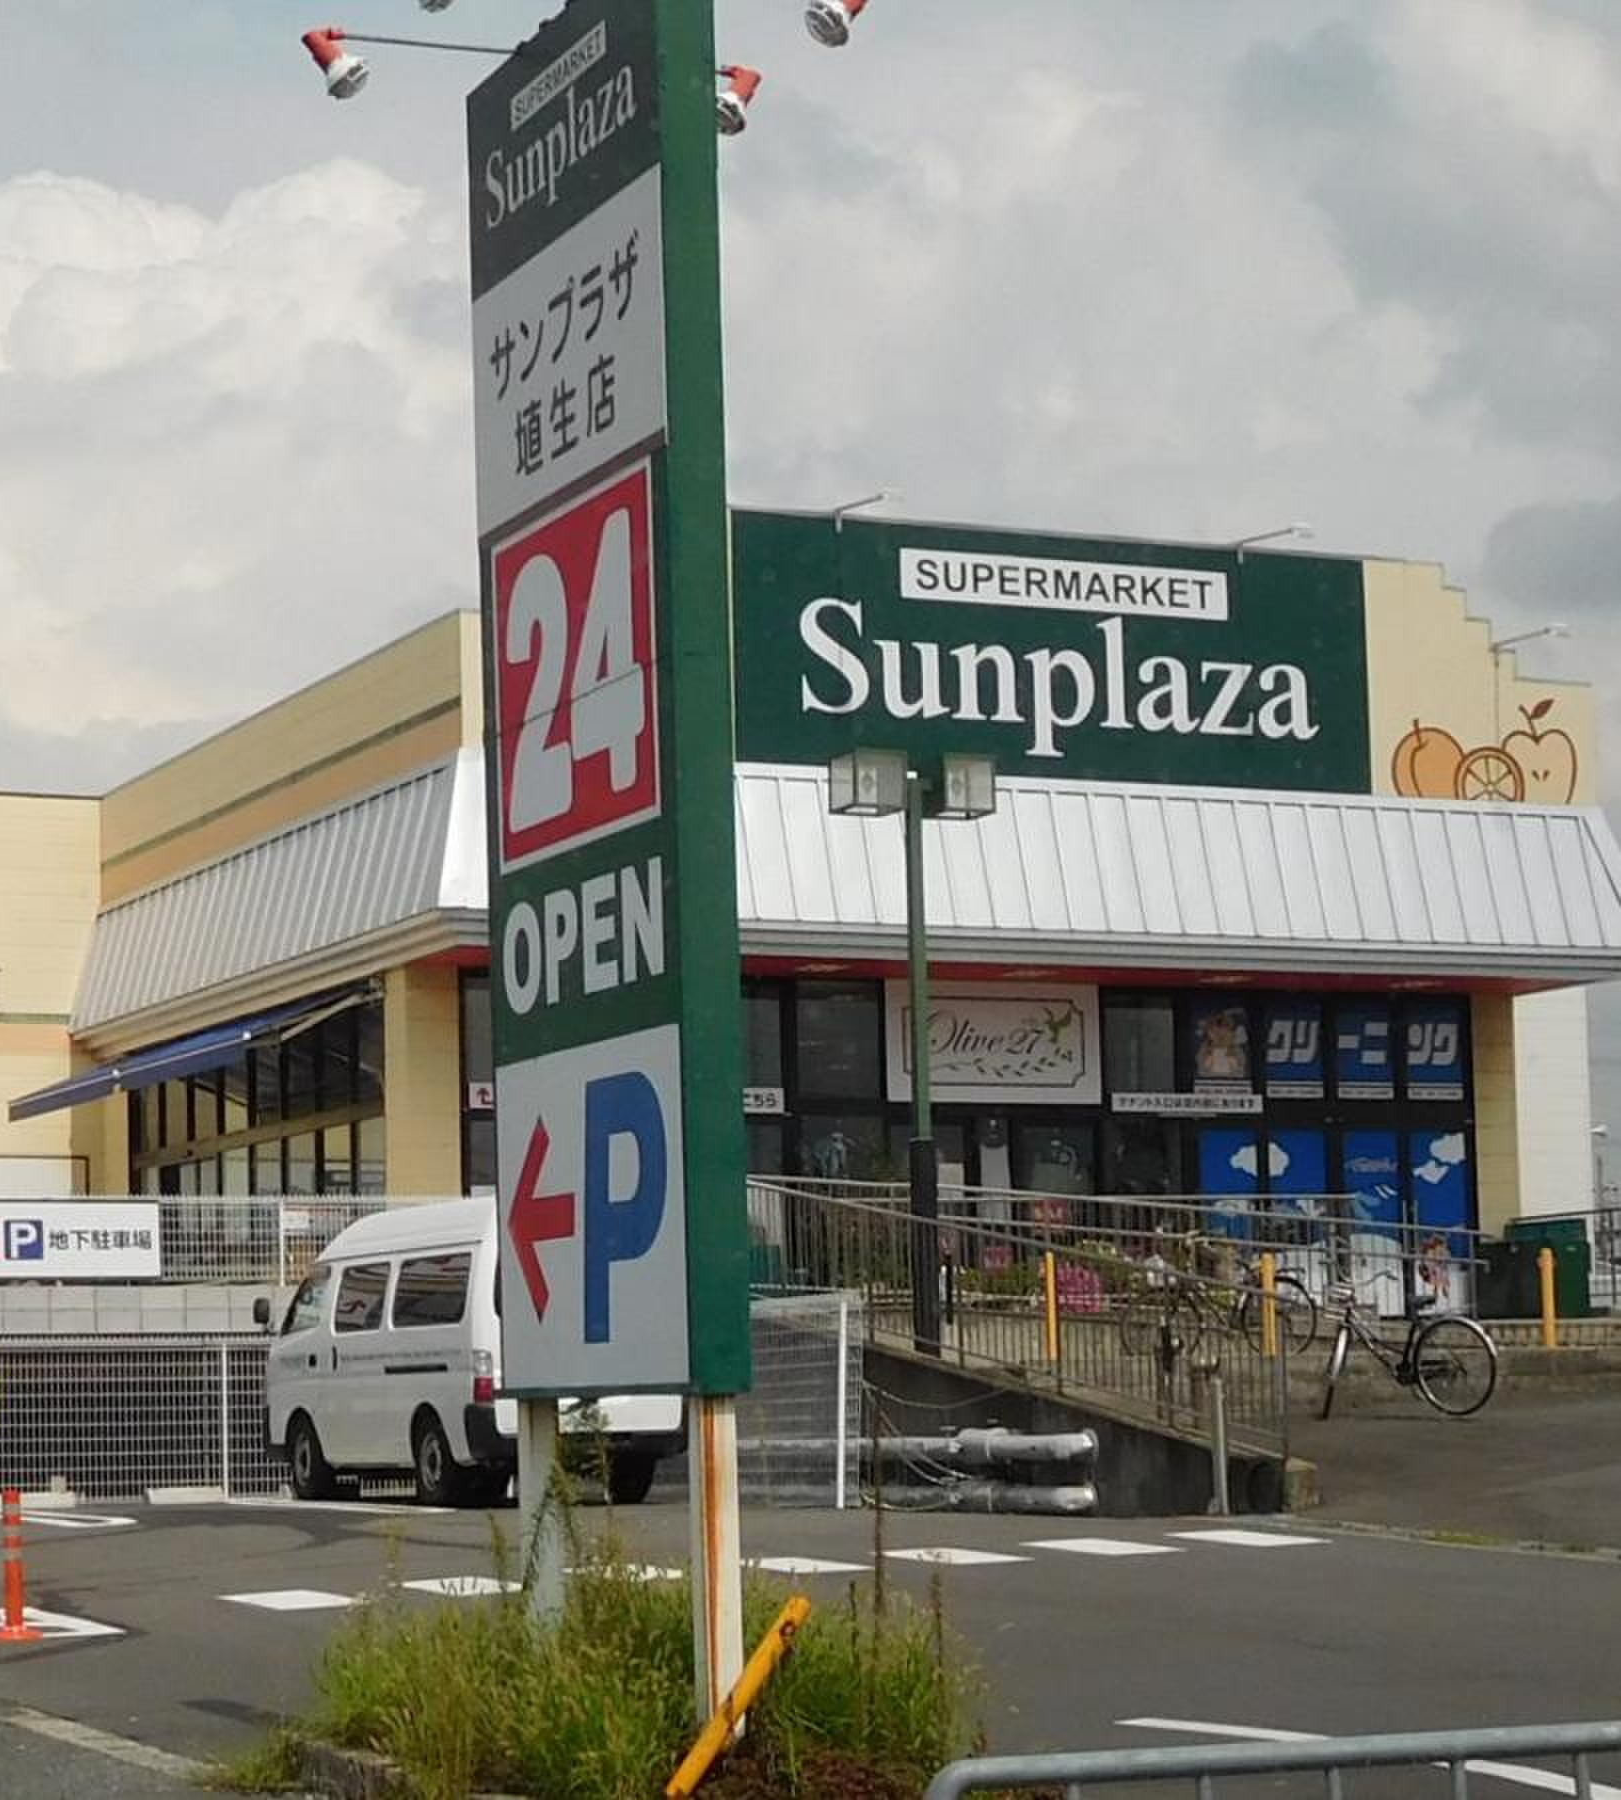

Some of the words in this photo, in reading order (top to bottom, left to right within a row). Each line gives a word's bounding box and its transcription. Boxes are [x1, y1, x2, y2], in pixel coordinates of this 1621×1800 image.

[485, 65, 636, 229] Sunplaza
[513, 30, 602, 123] SUPERMARKET
[489, 230, 639, 400] サンプラザ
[515, 353, 617, 476] 埴生店
[916, 559, 1212, 610] SUPERMARKET
[505, 507, 646, 833] 24
[799, 598, 1320, 757] Sunplaza
[503, 856, 665, 1015] OPEN
[10, 1223, 36, 1257] P
[49, 1229, 152, 1251] 地下駐車場
[584, 1071, 668, 1344] P
